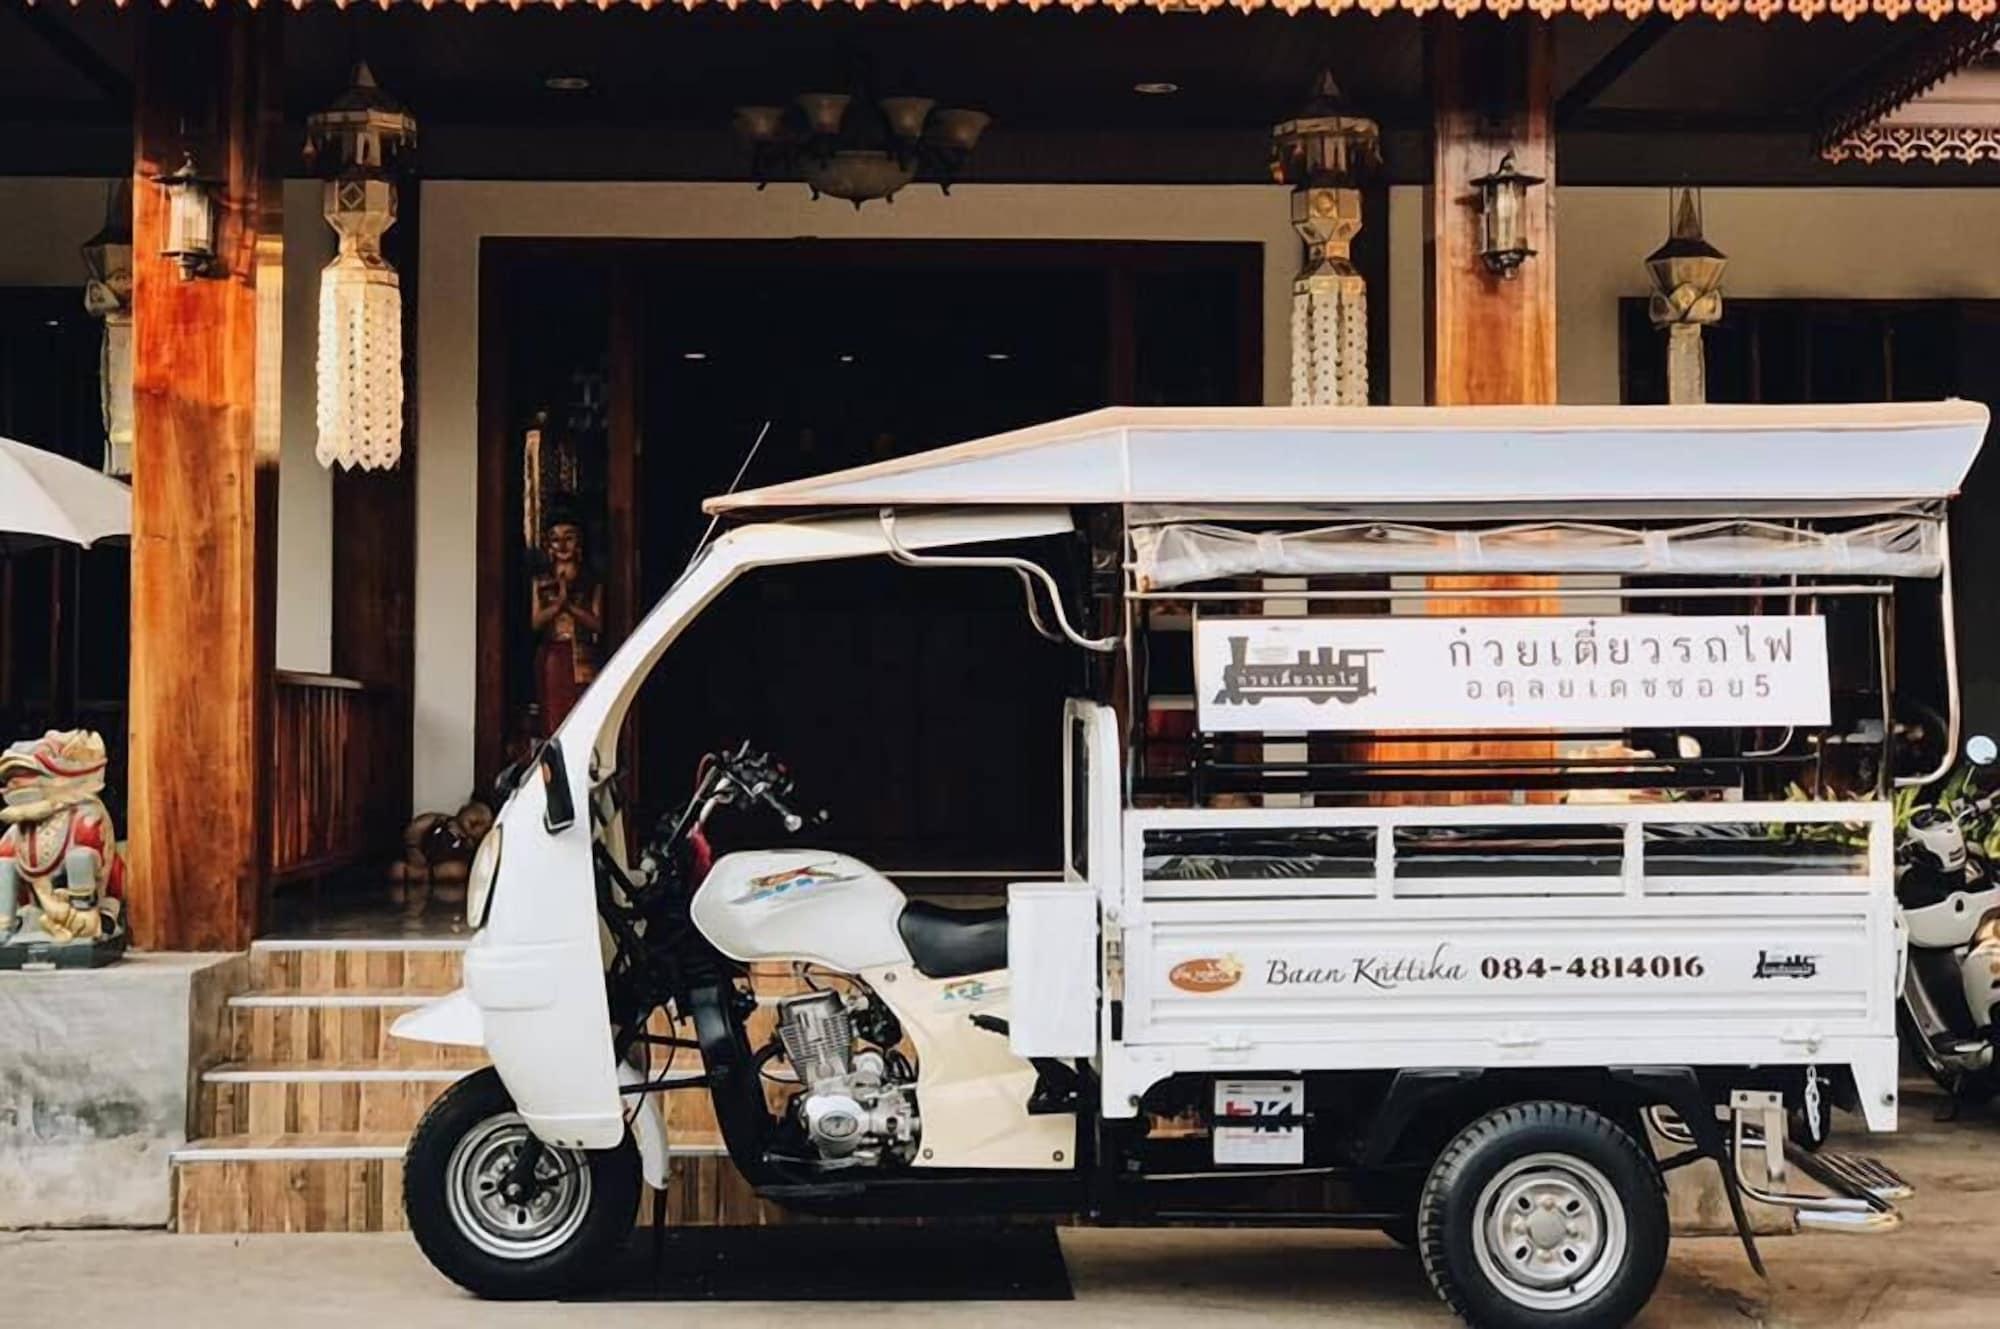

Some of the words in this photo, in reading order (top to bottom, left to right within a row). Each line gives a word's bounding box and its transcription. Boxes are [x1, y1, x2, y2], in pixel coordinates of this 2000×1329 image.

[1266, 958, 1346, 985] Baan
[1352, 942, 1468, 989] Krittika
[1480, 955, 1705, 980] 084-4814016
